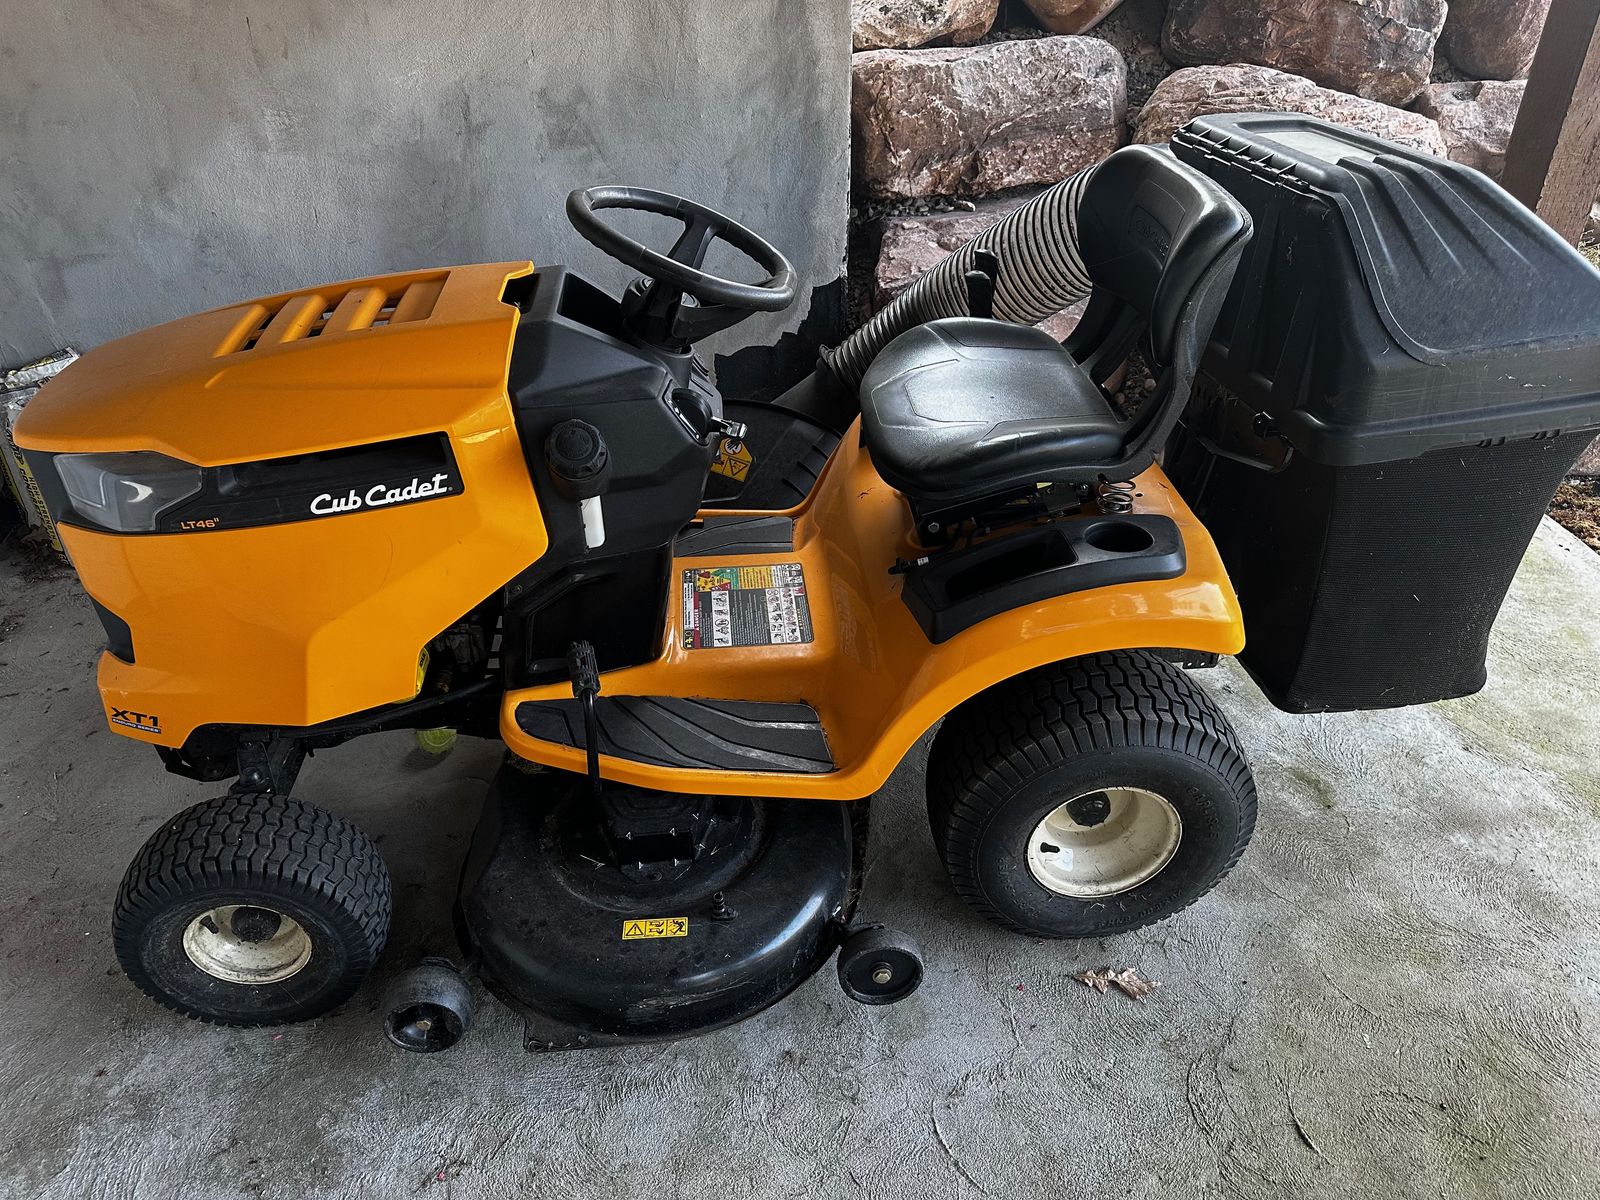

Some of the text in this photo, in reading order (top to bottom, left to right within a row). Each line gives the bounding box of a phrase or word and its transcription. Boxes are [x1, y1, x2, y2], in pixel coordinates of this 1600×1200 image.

[310, 473, 448, 515] Cub Cadet
[180, 517, 220, 530] LT46"
[111, 706, 158, 727] XT1
